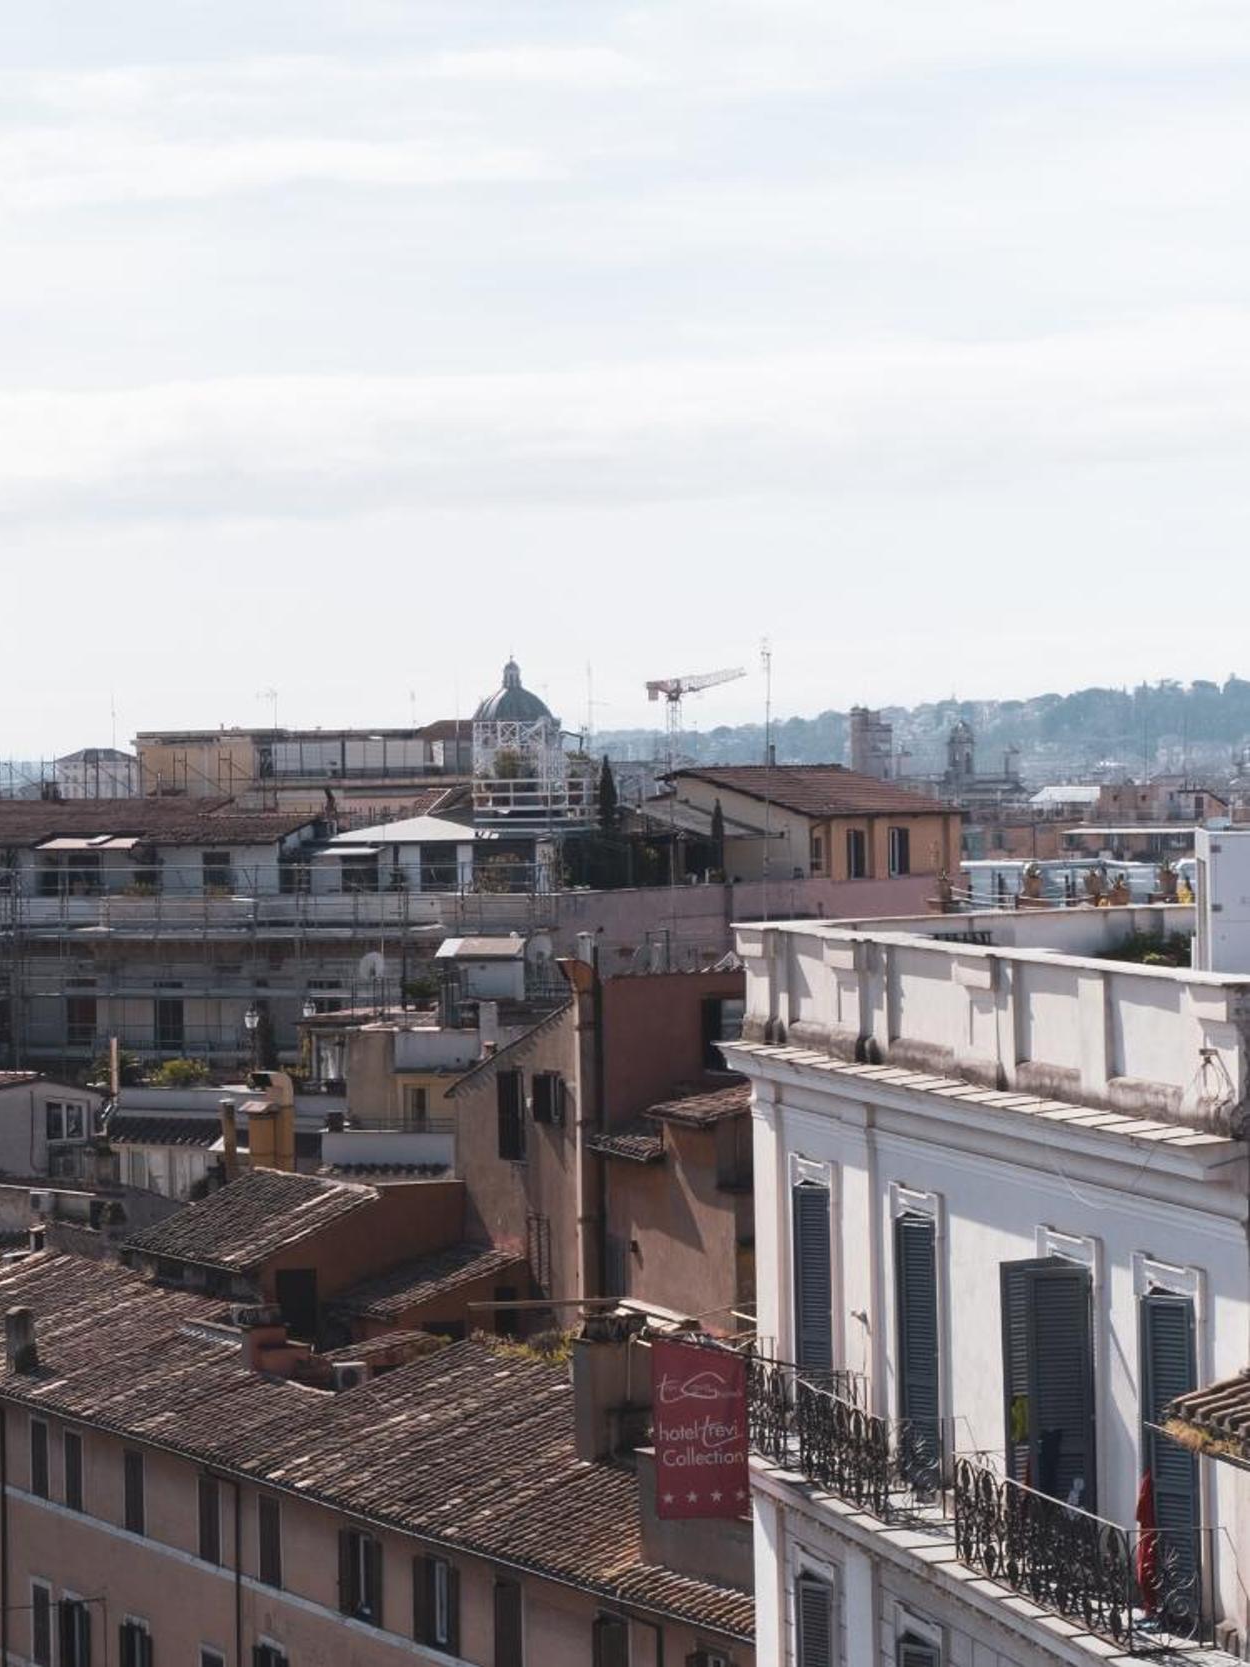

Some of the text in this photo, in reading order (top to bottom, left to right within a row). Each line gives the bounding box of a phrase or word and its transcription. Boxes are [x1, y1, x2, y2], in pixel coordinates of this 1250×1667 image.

[659, 1416, 742, 1448] hotel trevi
[662, 1447, 744, 1466] Collection
